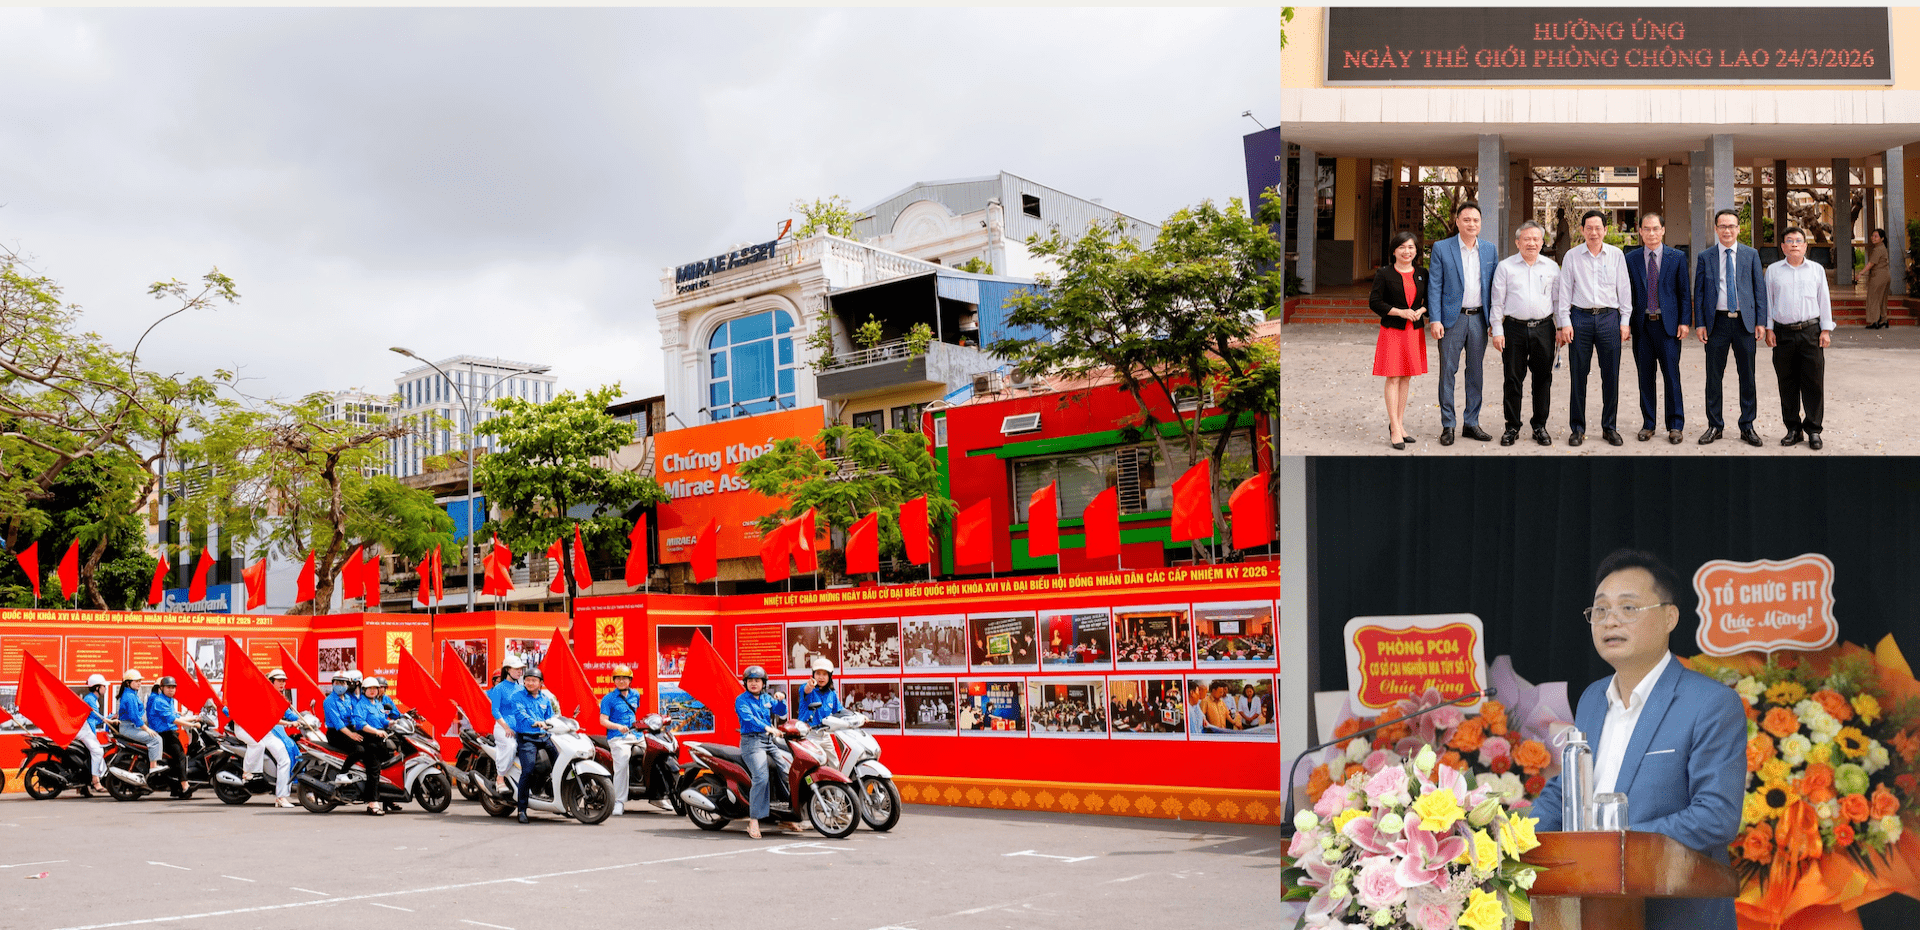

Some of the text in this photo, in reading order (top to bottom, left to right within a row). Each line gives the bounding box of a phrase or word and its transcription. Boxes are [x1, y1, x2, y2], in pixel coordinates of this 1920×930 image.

[1533, 18, 1686, 40] HƯỞNG ỨNG
[1343, 44, 1414, 68] NGÀY
[1474, 44, 1527, 68] GIỚI
[1532, 44, 1619, 68] PHÒNG
[1719, 48, 1770, 68] LAO
[1775, 48, 1875, 68] 24/3/2026
[676, 239, 778, 284] MIRAE ASSET
[662, 437, 775, 473] Chứng Khoá
[663, 474, 751, 499] Mirae Ass
[666, 536, 691, 547] MIRAE
[763, 594, 782, 607] NHIỆT
[784, 594, 798, 606] LIỆT
[799, 592, 818, 604] CHÀO
[819, 591, 840, 603] MỪNG
[841, 589, 861, 602] NGÀY
[862, 587, 877, 600] BẦU
[890, 588, 903, 600] ĐẠI
[904, 583, 922, 598] BIỂU
[924, 582, 944, 596] QUỐC
[946, 582, 960, 597] HỘI
[961, 581, 984, 595] KHÓA
[985, 582, 998, 593] XVI
[1000, 580, 1012, 592] VÀ
[1013, 580, 1028, 593] ĐẠI
[1029, 575, 1050, 590] BIỂU
[1051, 576, 1067, 591] HỘI
[1068, 574, 1094, 588] ĐỒNG
[1095, 572, 1122, 586] NHÂN
[1124, 571, 1144, 585] DÂN
[1146, 570, 1166, 583] CÁC
[1167, 566, 1188, 582] CẤP
[1190, 566, 1224, 582] NHIỆM
[1225, 565, 1240, 579] KỲ
[1242, 566, 1268, 578] 2026
[1739, 579, 1787, 604] CHỨC
[1792, 580, 1817, 600] FIT
[2, 609, 22, 620] QUỐC
[23, 610, 36, 622] HỘI
[37, 611, 56, 621] KHÓA
[57, 612, 70, 621] XVI
[70, 611, 80, 621] VÀ
[144, 613, 162, 623] NHÂN
[163, 614, 177, 623] DÂN
[178, 614, 191, 623] CÁC
[192, 613, 205, 624] CẤP
[1719, 613, 1756, 634] Chúc
[1377, 637, 1460, 656] PHÒNG PC04
[1428, 661, 1440, 675] MA
[1466, 660, 1470, 673] 1
[1379, 678, 1465, 696] Chúc Mừng
